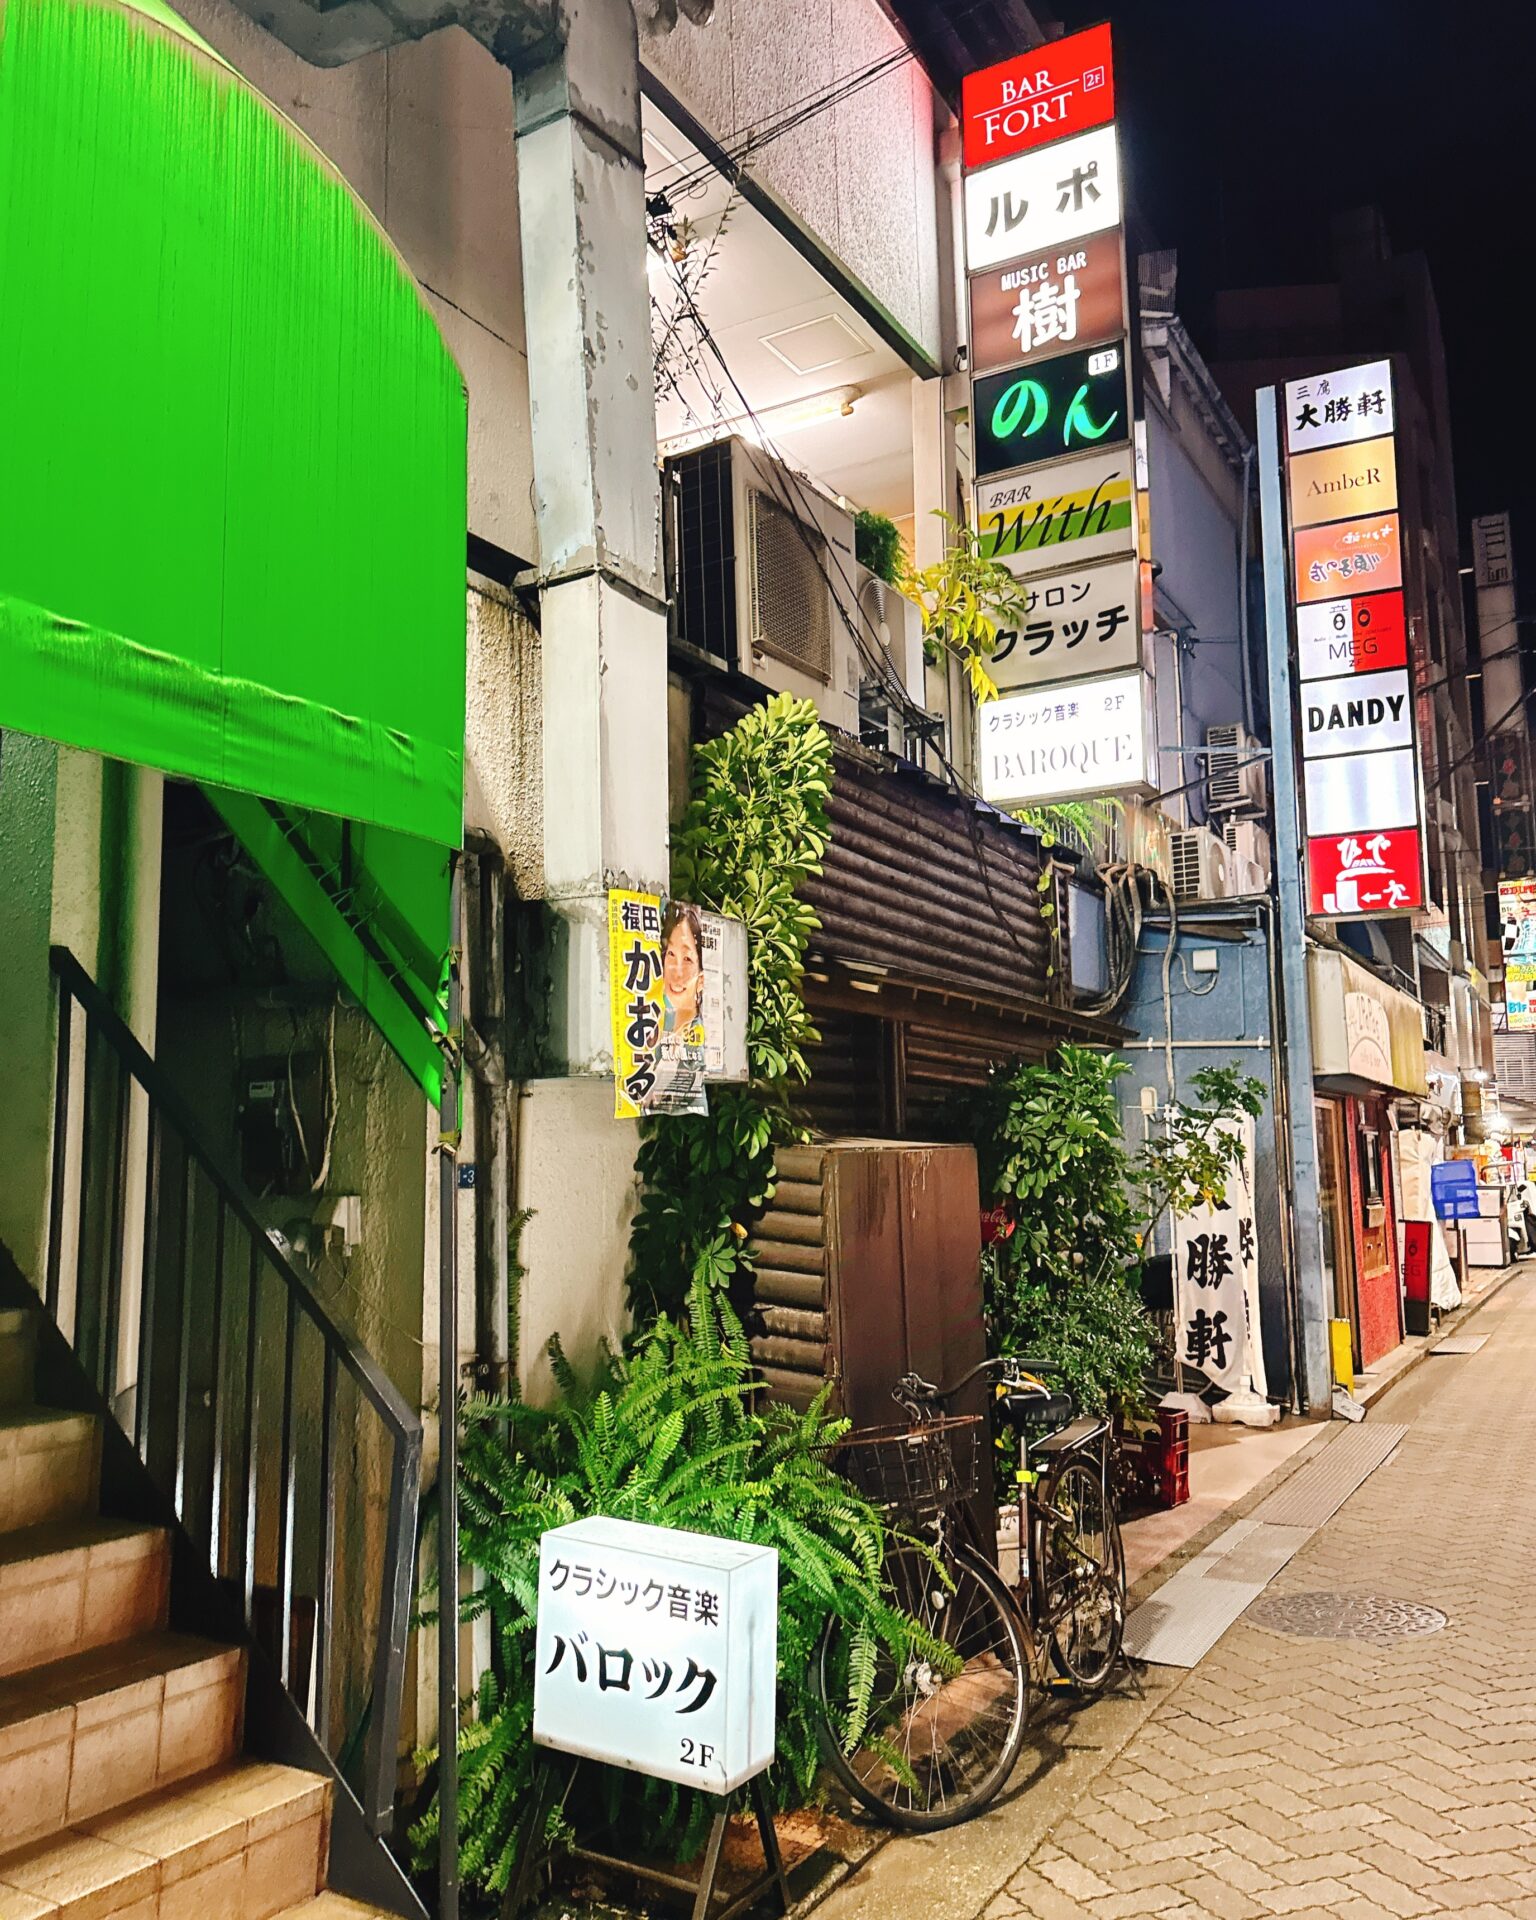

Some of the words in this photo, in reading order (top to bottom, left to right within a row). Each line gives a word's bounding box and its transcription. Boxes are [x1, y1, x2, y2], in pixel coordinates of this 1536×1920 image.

[1001, 70, 1054, 105] BAR
[1086, 73, 1101, 88] 2F
[983, 91, 1073, 146] FORT
[984, 160, 1102, 238] ルポ
[1001, 267, 1049, 291] MUSIC
[1056, 252, 1087, 274] BAR
[1011, 274, 1081, 353] 樹
[1093, 352, 1114, 371] 1F
[991, 379, 1118, 447] のん
[1294, 389, 1386, 431] 大勝軒
[989, 471, 1121, 558] With
[990, 485, 1032, 508] BAR
[991, 604, 1130, 663] クラッチ
[1328, 636, 1378, 660] MEG
[989, 702, 1079, 732] クラシック音楽
[1104, 695, 1125, 711] 2F
[1308, 695, 1405, 733] DANDY
[993, 734, 1133, 781] BAROQUE
[622, 901, 661, 933] 福田
[624, 940, 662, 1102] かおる
[549, 1559, 719, 1626] クラシック音楽
[545, 1630, 717, 1713] バロック
[679, 1738, 715, 1768] 2F
